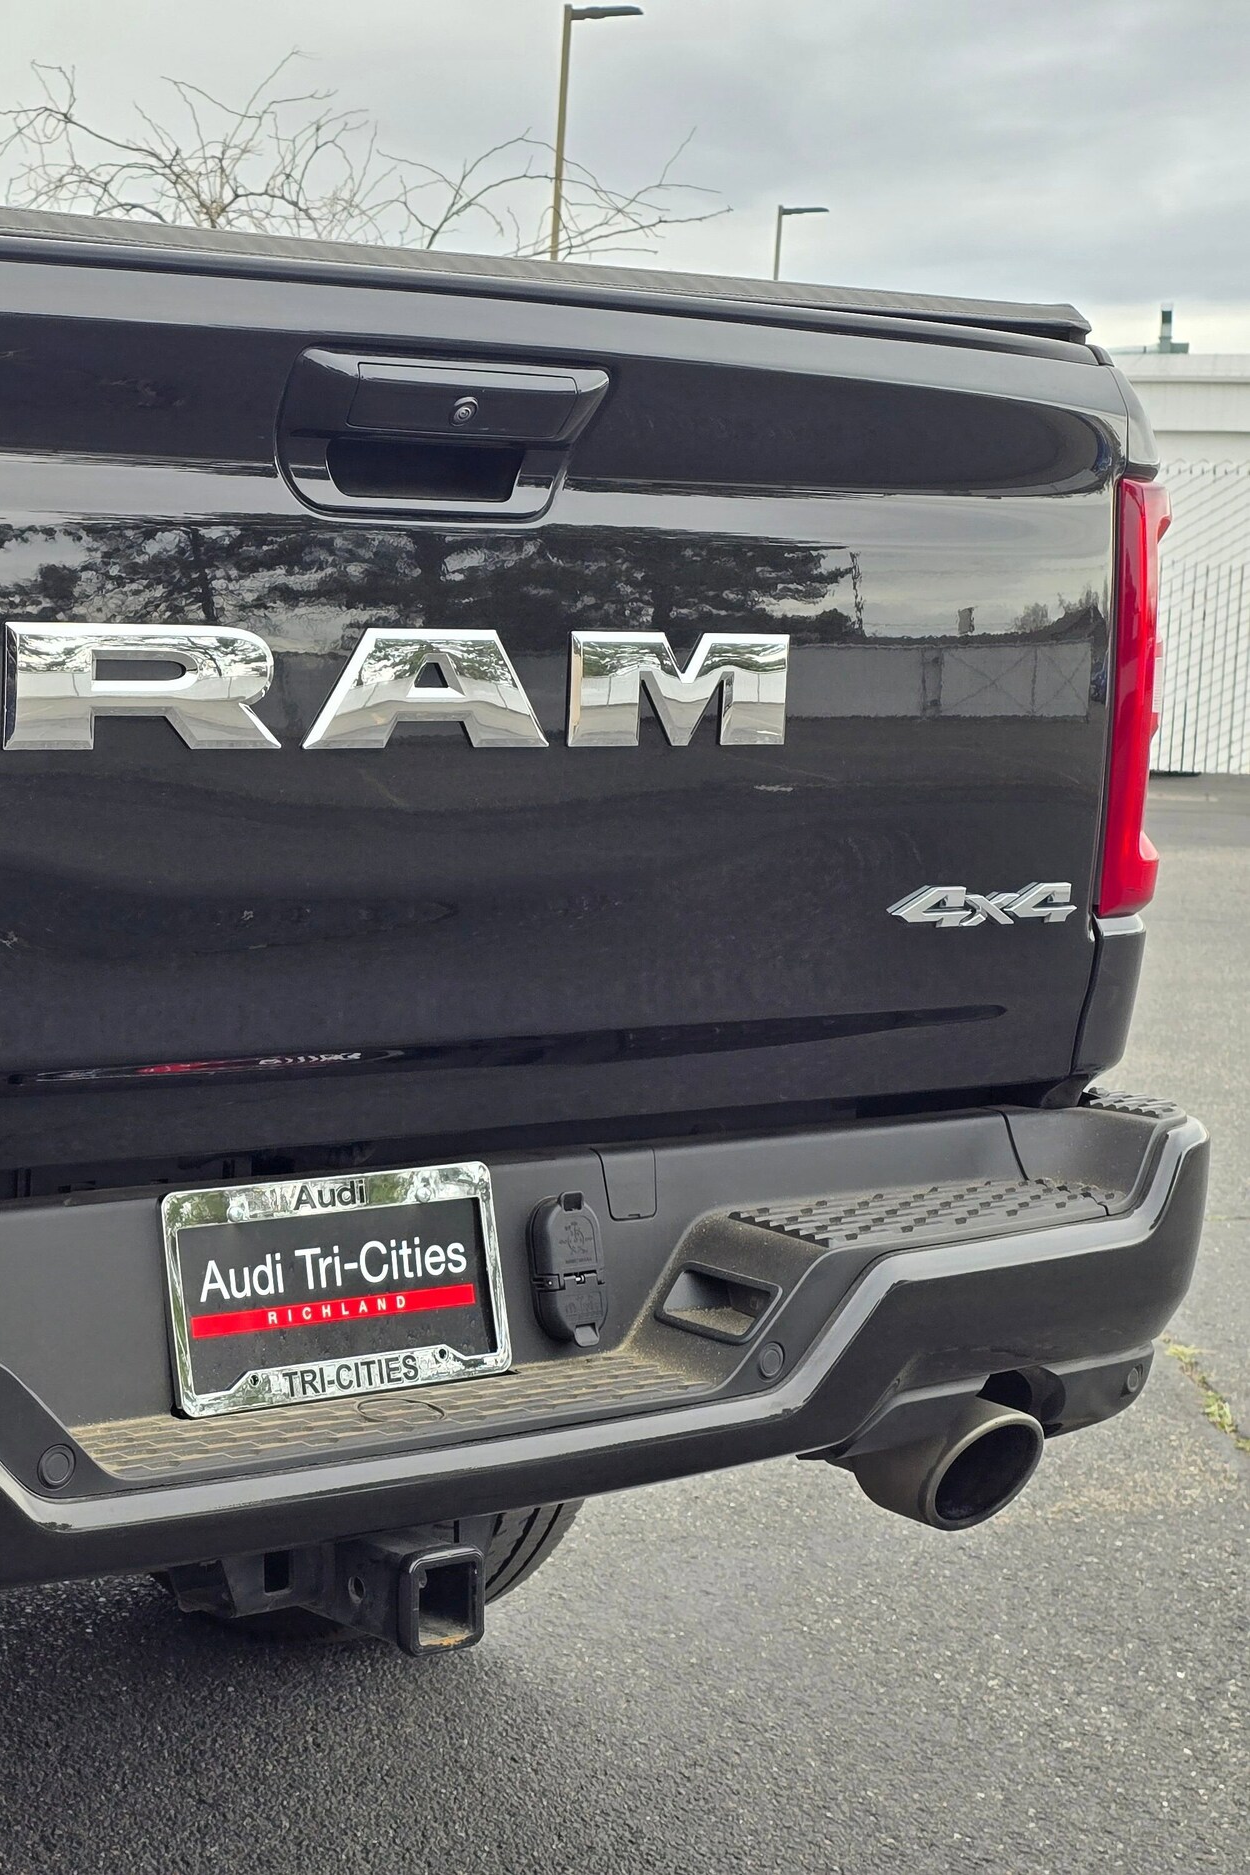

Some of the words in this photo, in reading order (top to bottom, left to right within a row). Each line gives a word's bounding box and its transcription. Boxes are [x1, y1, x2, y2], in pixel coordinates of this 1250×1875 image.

[1, 620, 791, 750] RAM
[886, 881, 1078, 928] 4x4
[293, 1179, 367, 1211] Audi
[200, 1253, 284, 1303] Audi
[294, 1236, 468, 1291] Tri-Cities
[267, 1295, 407, 1325] RICHLAND
[282, 1354, 420, 1398] TRI-CITIES
